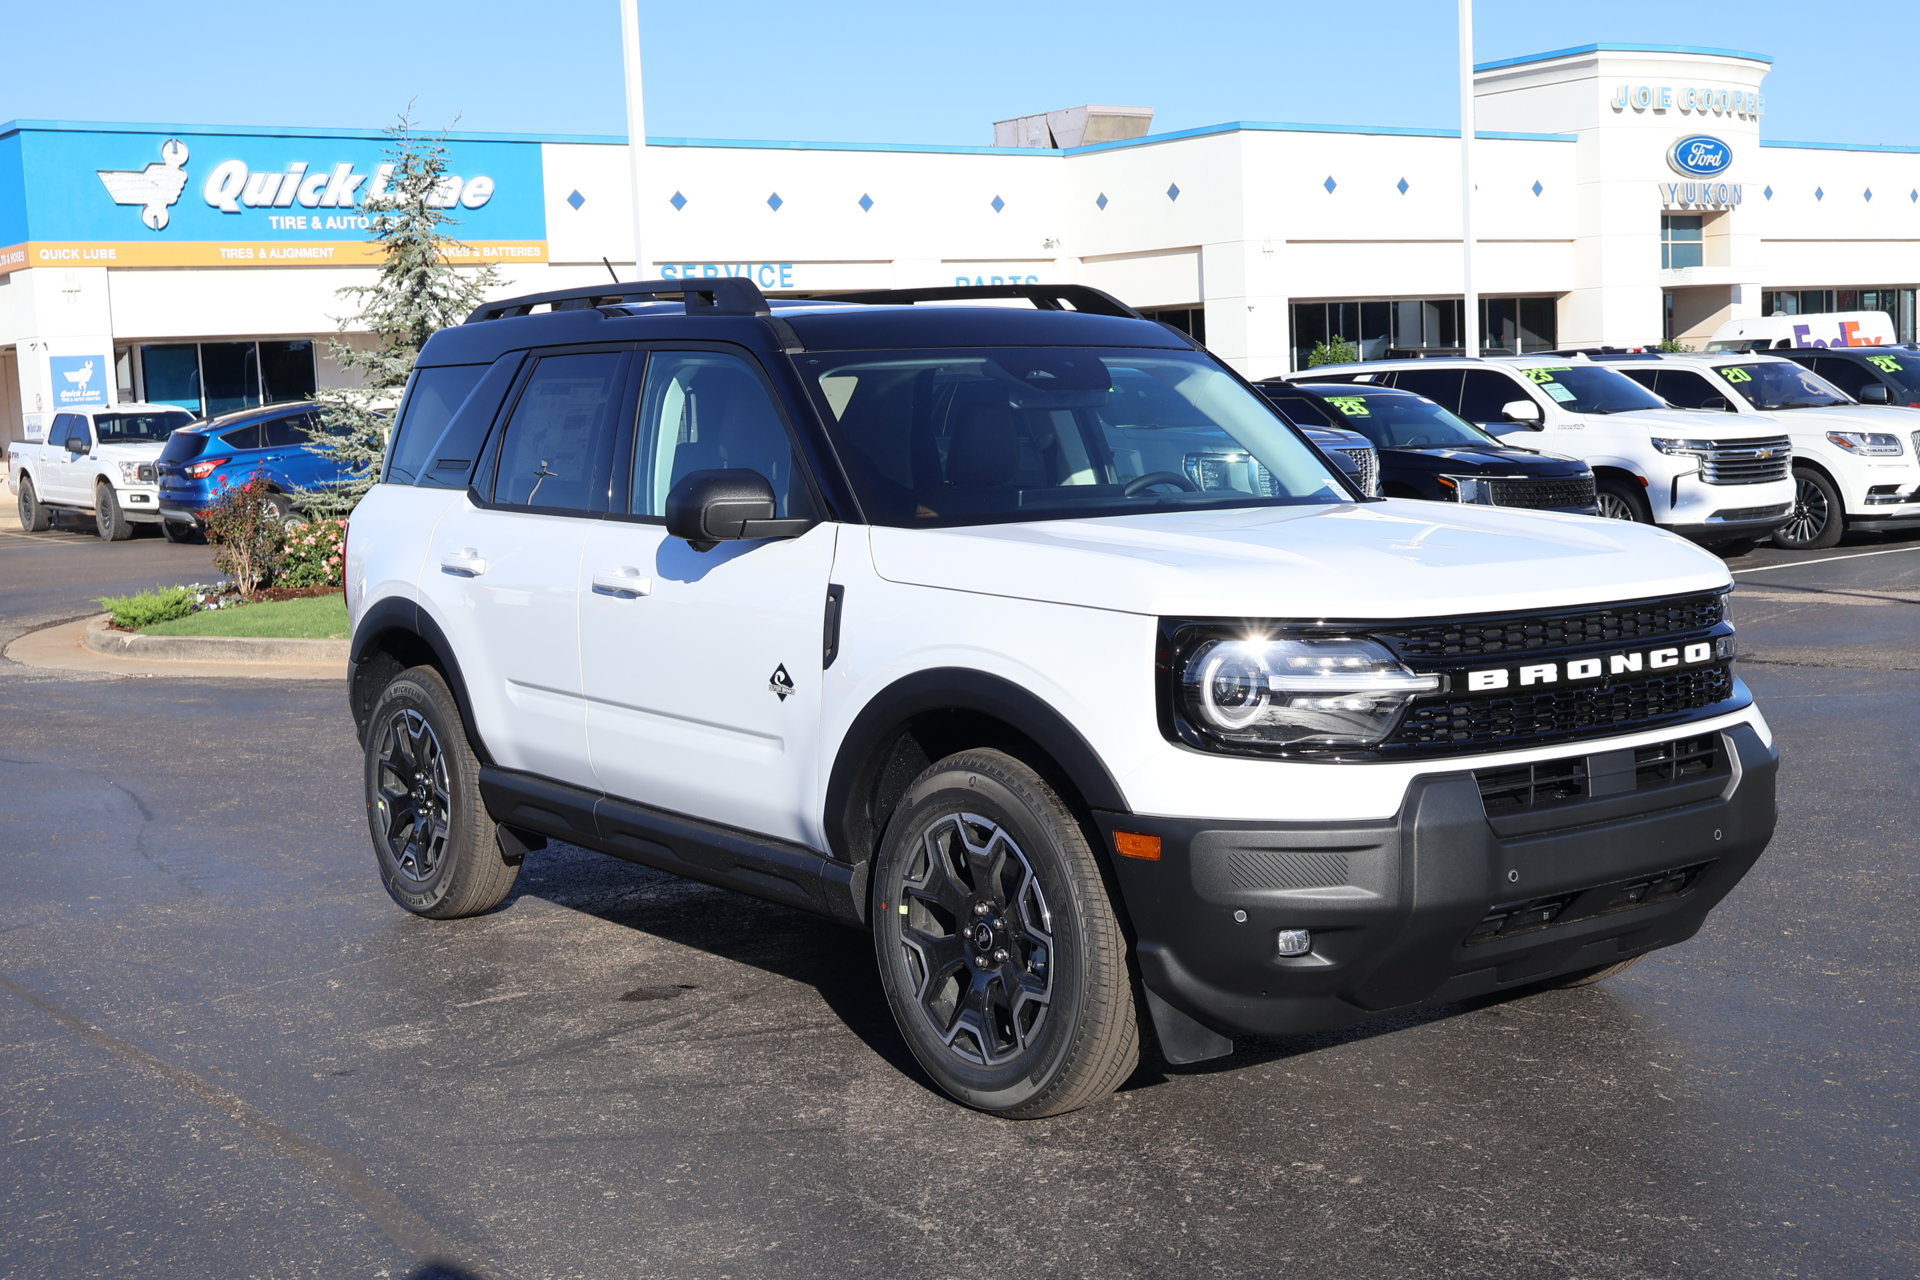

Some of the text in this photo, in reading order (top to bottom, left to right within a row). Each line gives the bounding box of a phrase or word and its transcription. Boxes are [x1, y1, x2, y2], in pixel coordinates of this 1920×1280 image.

[1614, 86, 1765, 115] JOE COOPER
[1687, 142, 1723, 167] Ford
[202, 159, 496, 213] Quick Lne
[1666, 183, 1743, 205] YUKON
[269, 216, 308, 230] TIRE
[310, 216, 323, 230] &
[325, 216, 371, 230] AUTO
[39, 249, 117, 260] QUICK LUBE
[219, 247, 335, 259] TIRES & ALIGNMENT
[472, 247, 481, 257] &
[483, 247, 541, 257] BATTERIES
[660, 263, 794, 288] SERVICE
[1521, 368, 1554, 384] 23
[1721, 368, 1752, 383] 20
[1468, 642, 1711, 692] BRONCO
